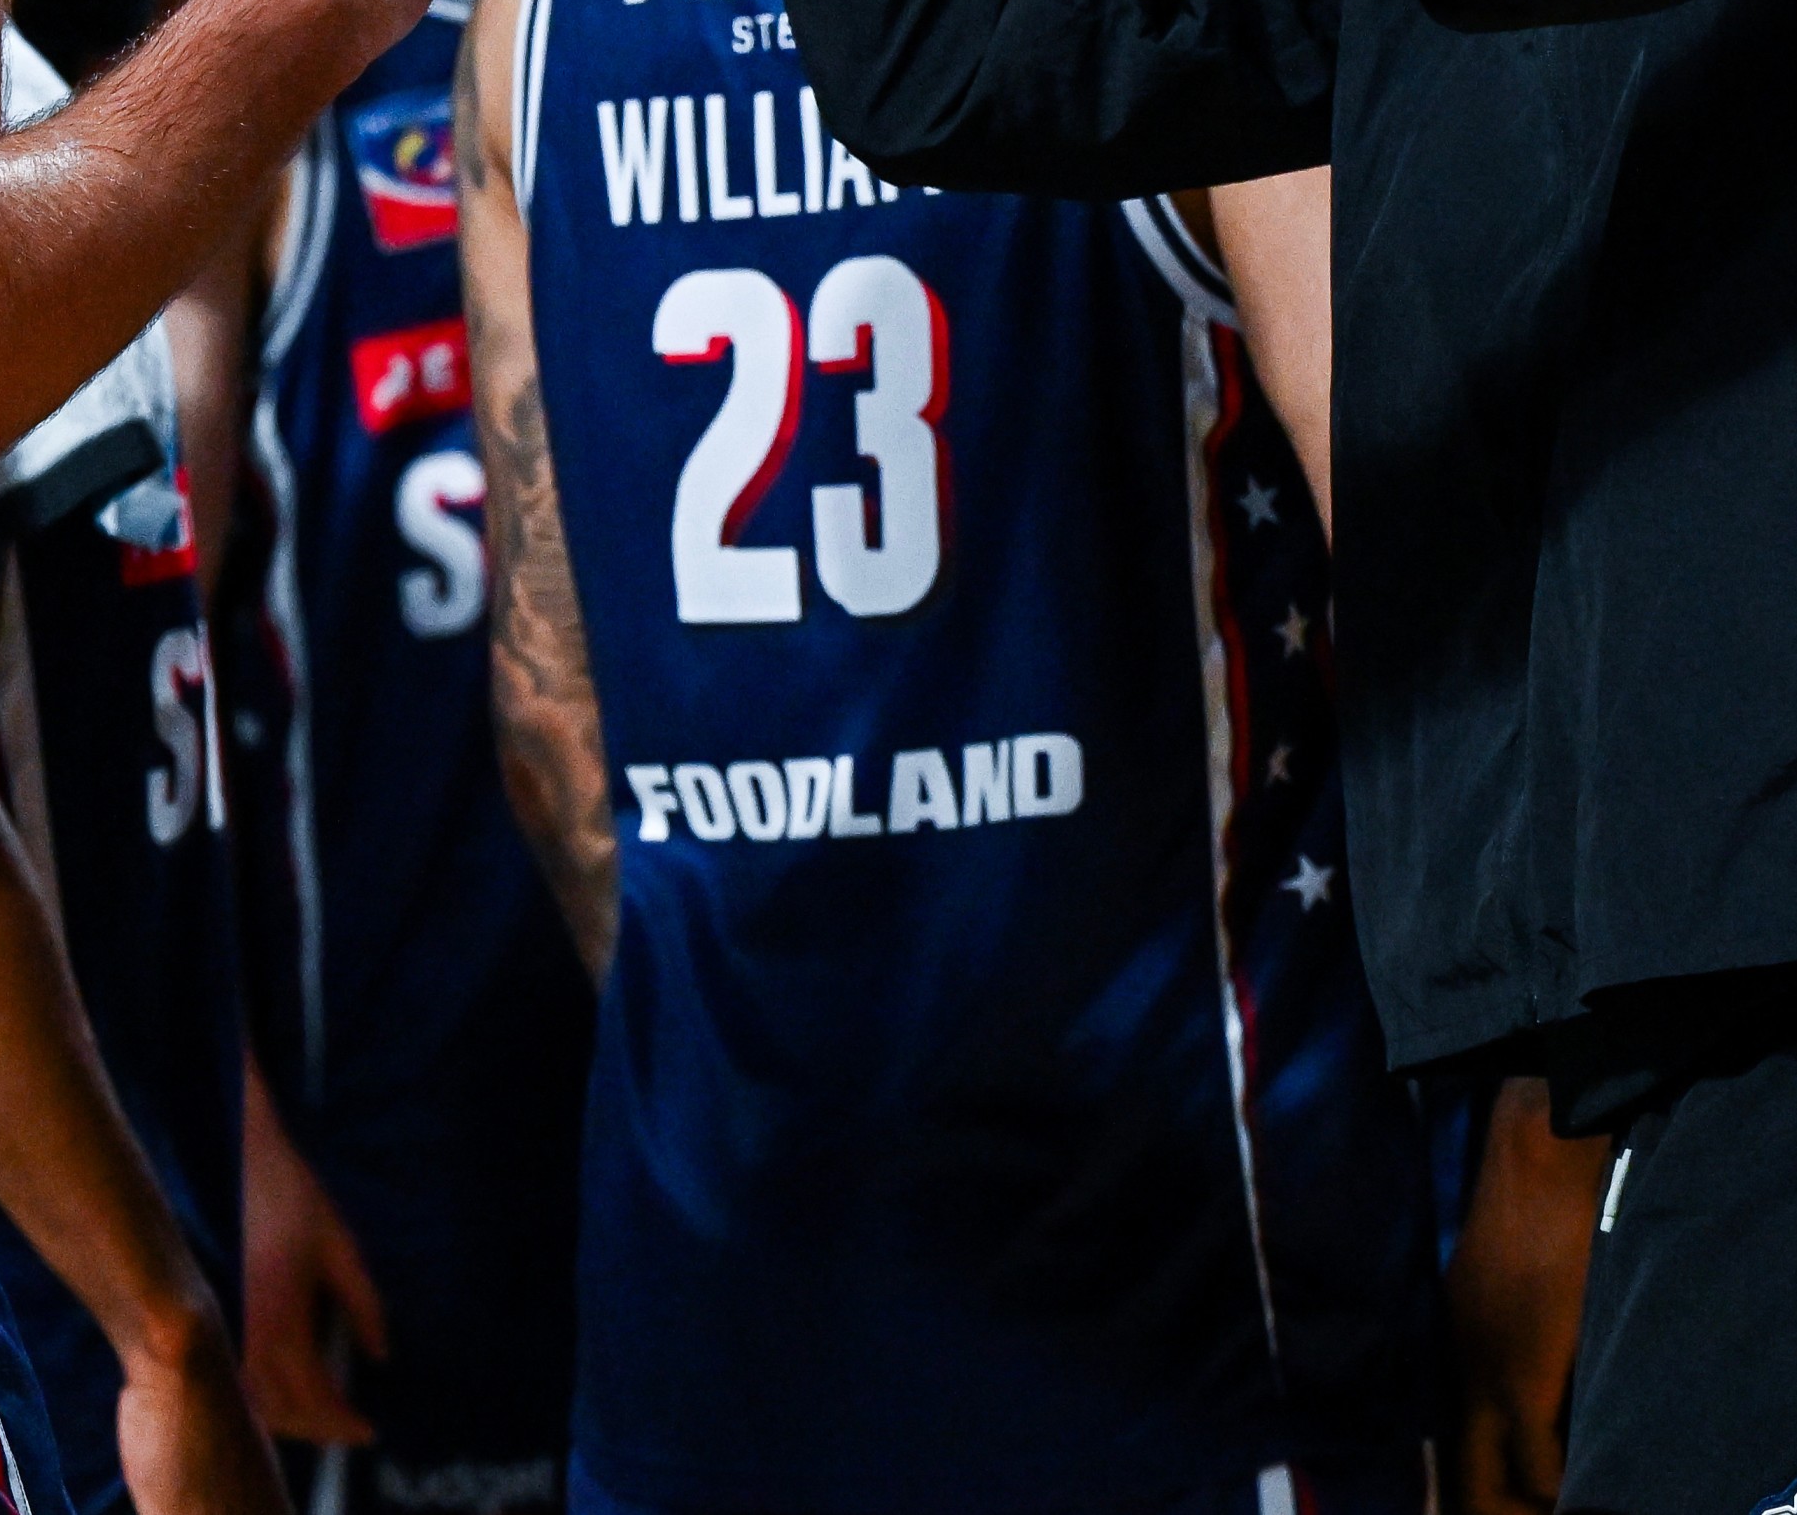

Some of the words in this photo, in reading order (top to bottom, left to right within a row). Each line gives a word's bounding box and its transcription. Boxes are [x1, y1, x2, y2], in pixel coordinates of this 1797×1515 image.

[731, 11, 797, 54] STE
[597, 86, 944, 228] WILLIA
[652, 254, 953, 623] 23
[625, 732, 1084, 842] FOODLAND
